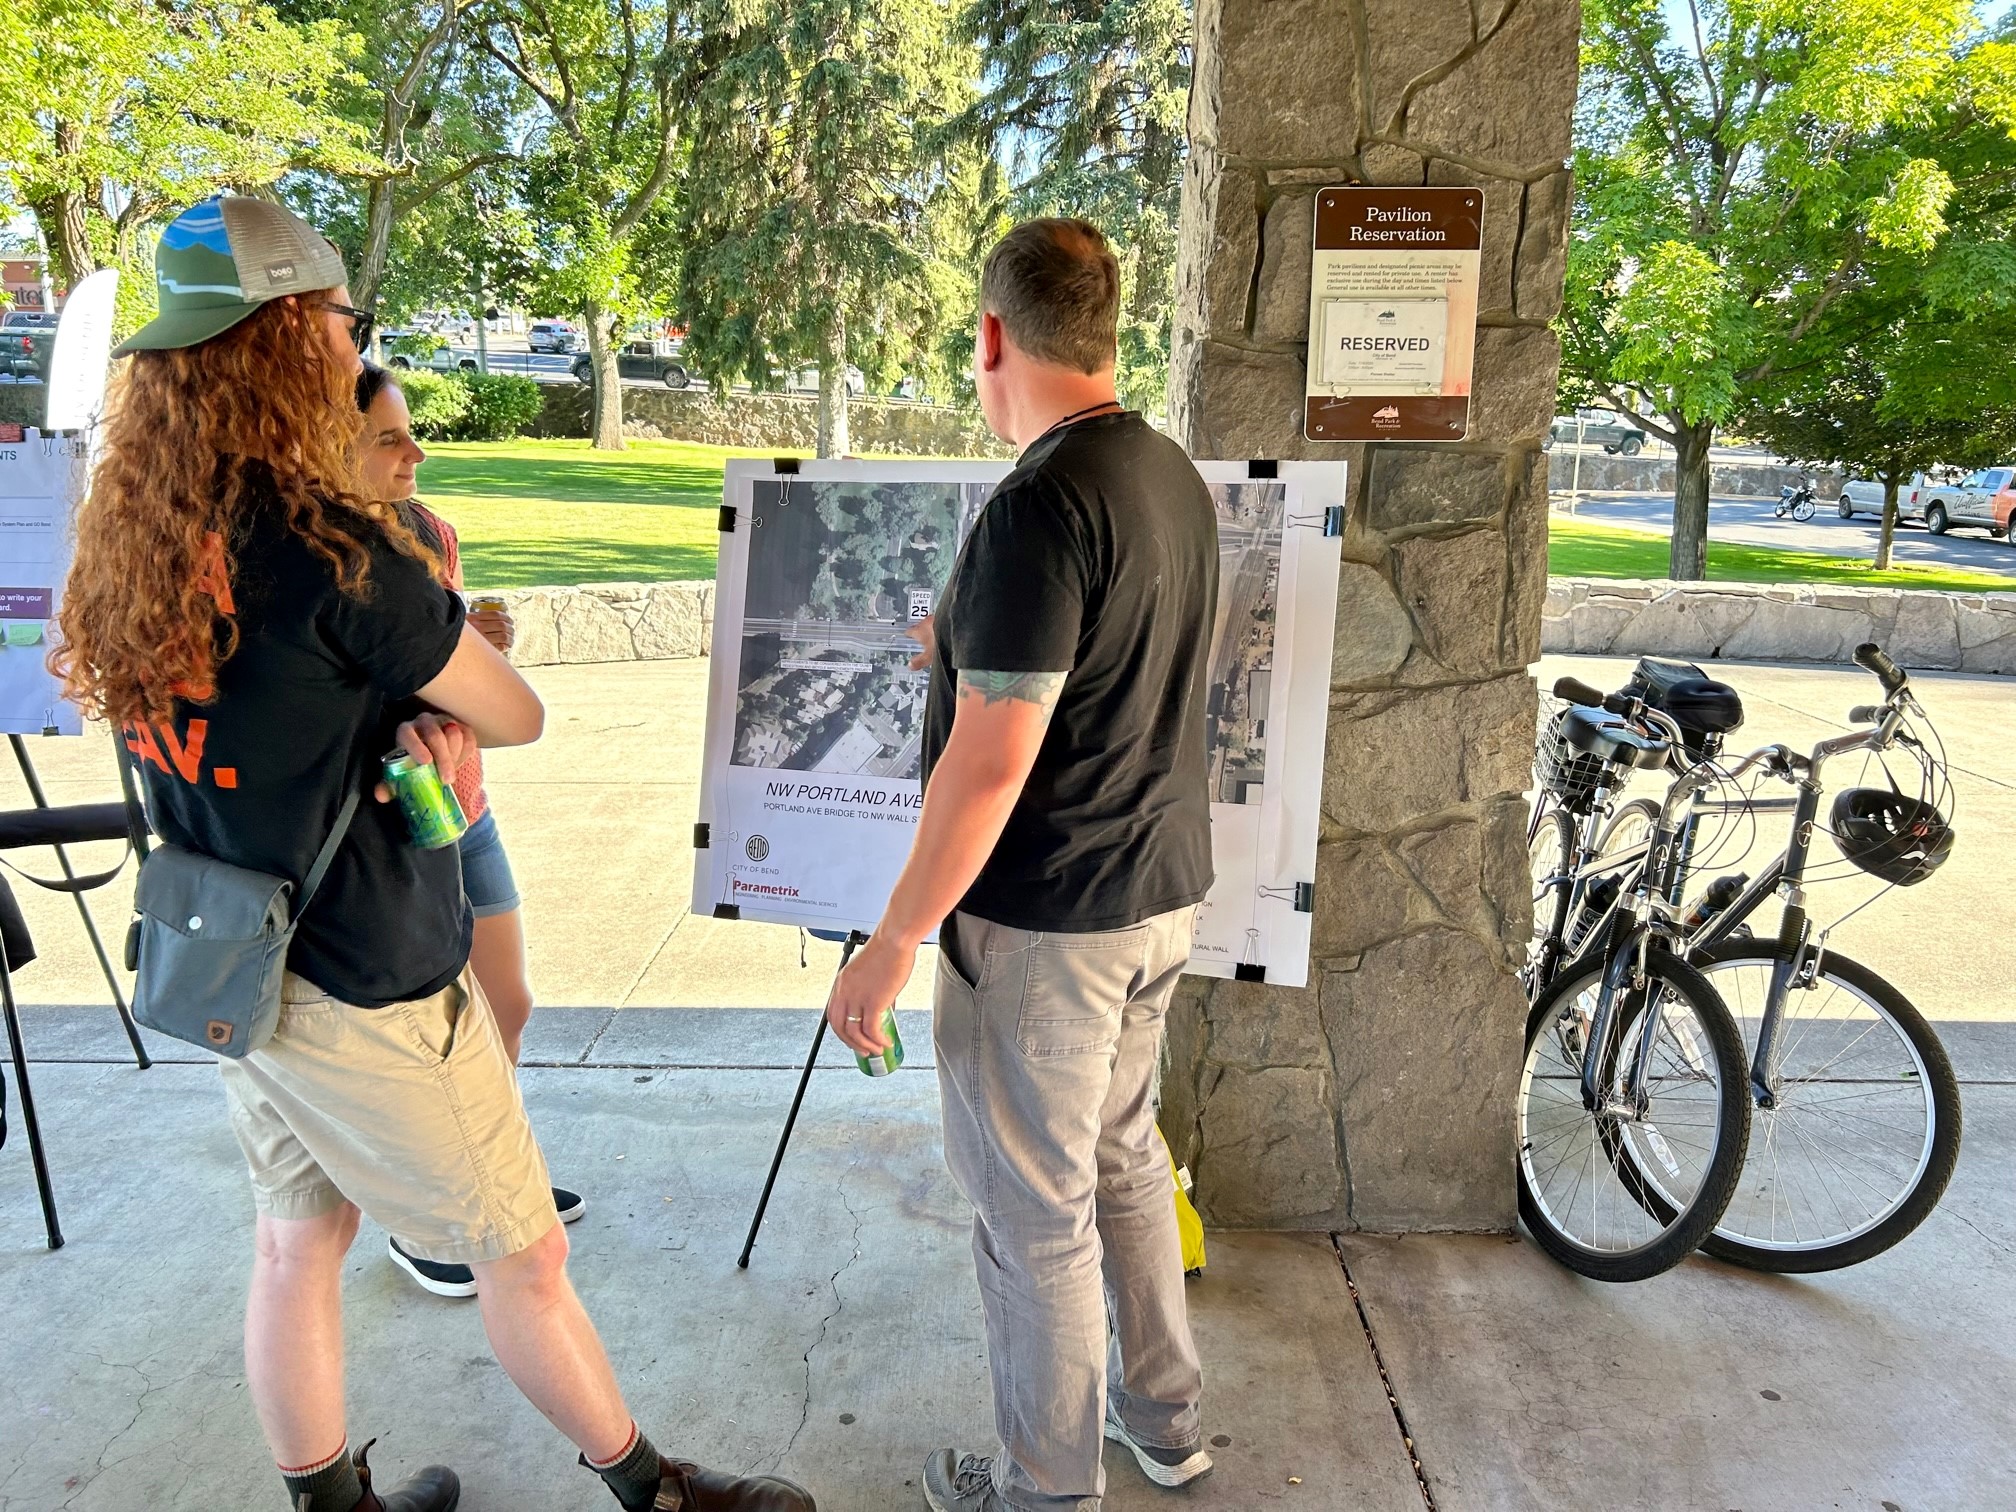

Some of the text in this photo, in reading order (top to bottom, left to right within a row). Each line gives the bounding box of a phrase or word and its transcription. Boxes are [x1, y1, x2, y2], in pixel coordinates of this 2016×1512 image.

[1366, 207, 1432, 222] Pavilion
[1350, 226, 1446, 242] Reservation
[1340, 337, 1430, 351] RESERVED
[7, 593, 25, 601] write
[26, 595, 42, 603] your
[911, 606, 929, 617] 25
[766, 782, 923, 809] NW PORTLAND AVE
[764, 802, 920, 823] PORTLAND AVE BRIDGE TO NW WALL S
[748, 837, 767, 859] BEND
[761, 867, 780, 875] BEND
[734, 880, 800, 897] Parametrix
